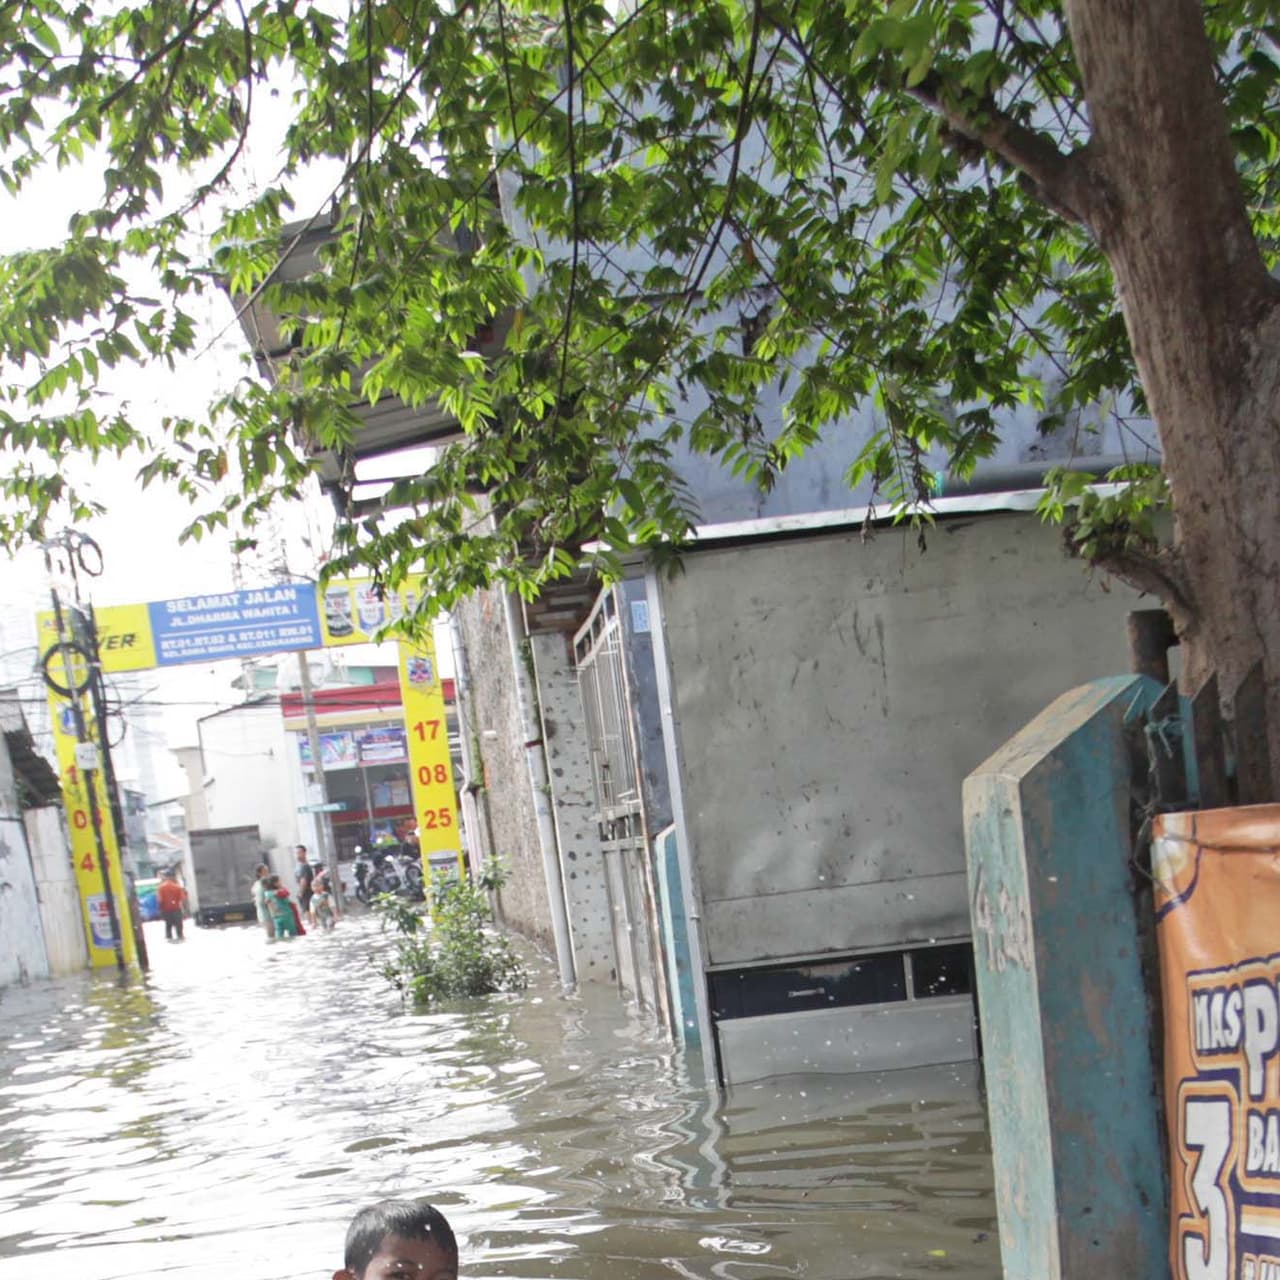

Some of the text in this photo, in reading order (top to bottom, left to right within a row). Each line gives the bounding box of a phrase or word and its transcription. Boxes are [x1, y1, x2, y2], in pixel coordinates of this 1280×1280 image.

[167, 588, 297, 613] SELAMAT JALAN
[414, 719, 441, 742] 17
[418, 764, 448, 786] 08
[424, 808, 452, 830] 25
[1193, 987, 1242, 1050] MAS
